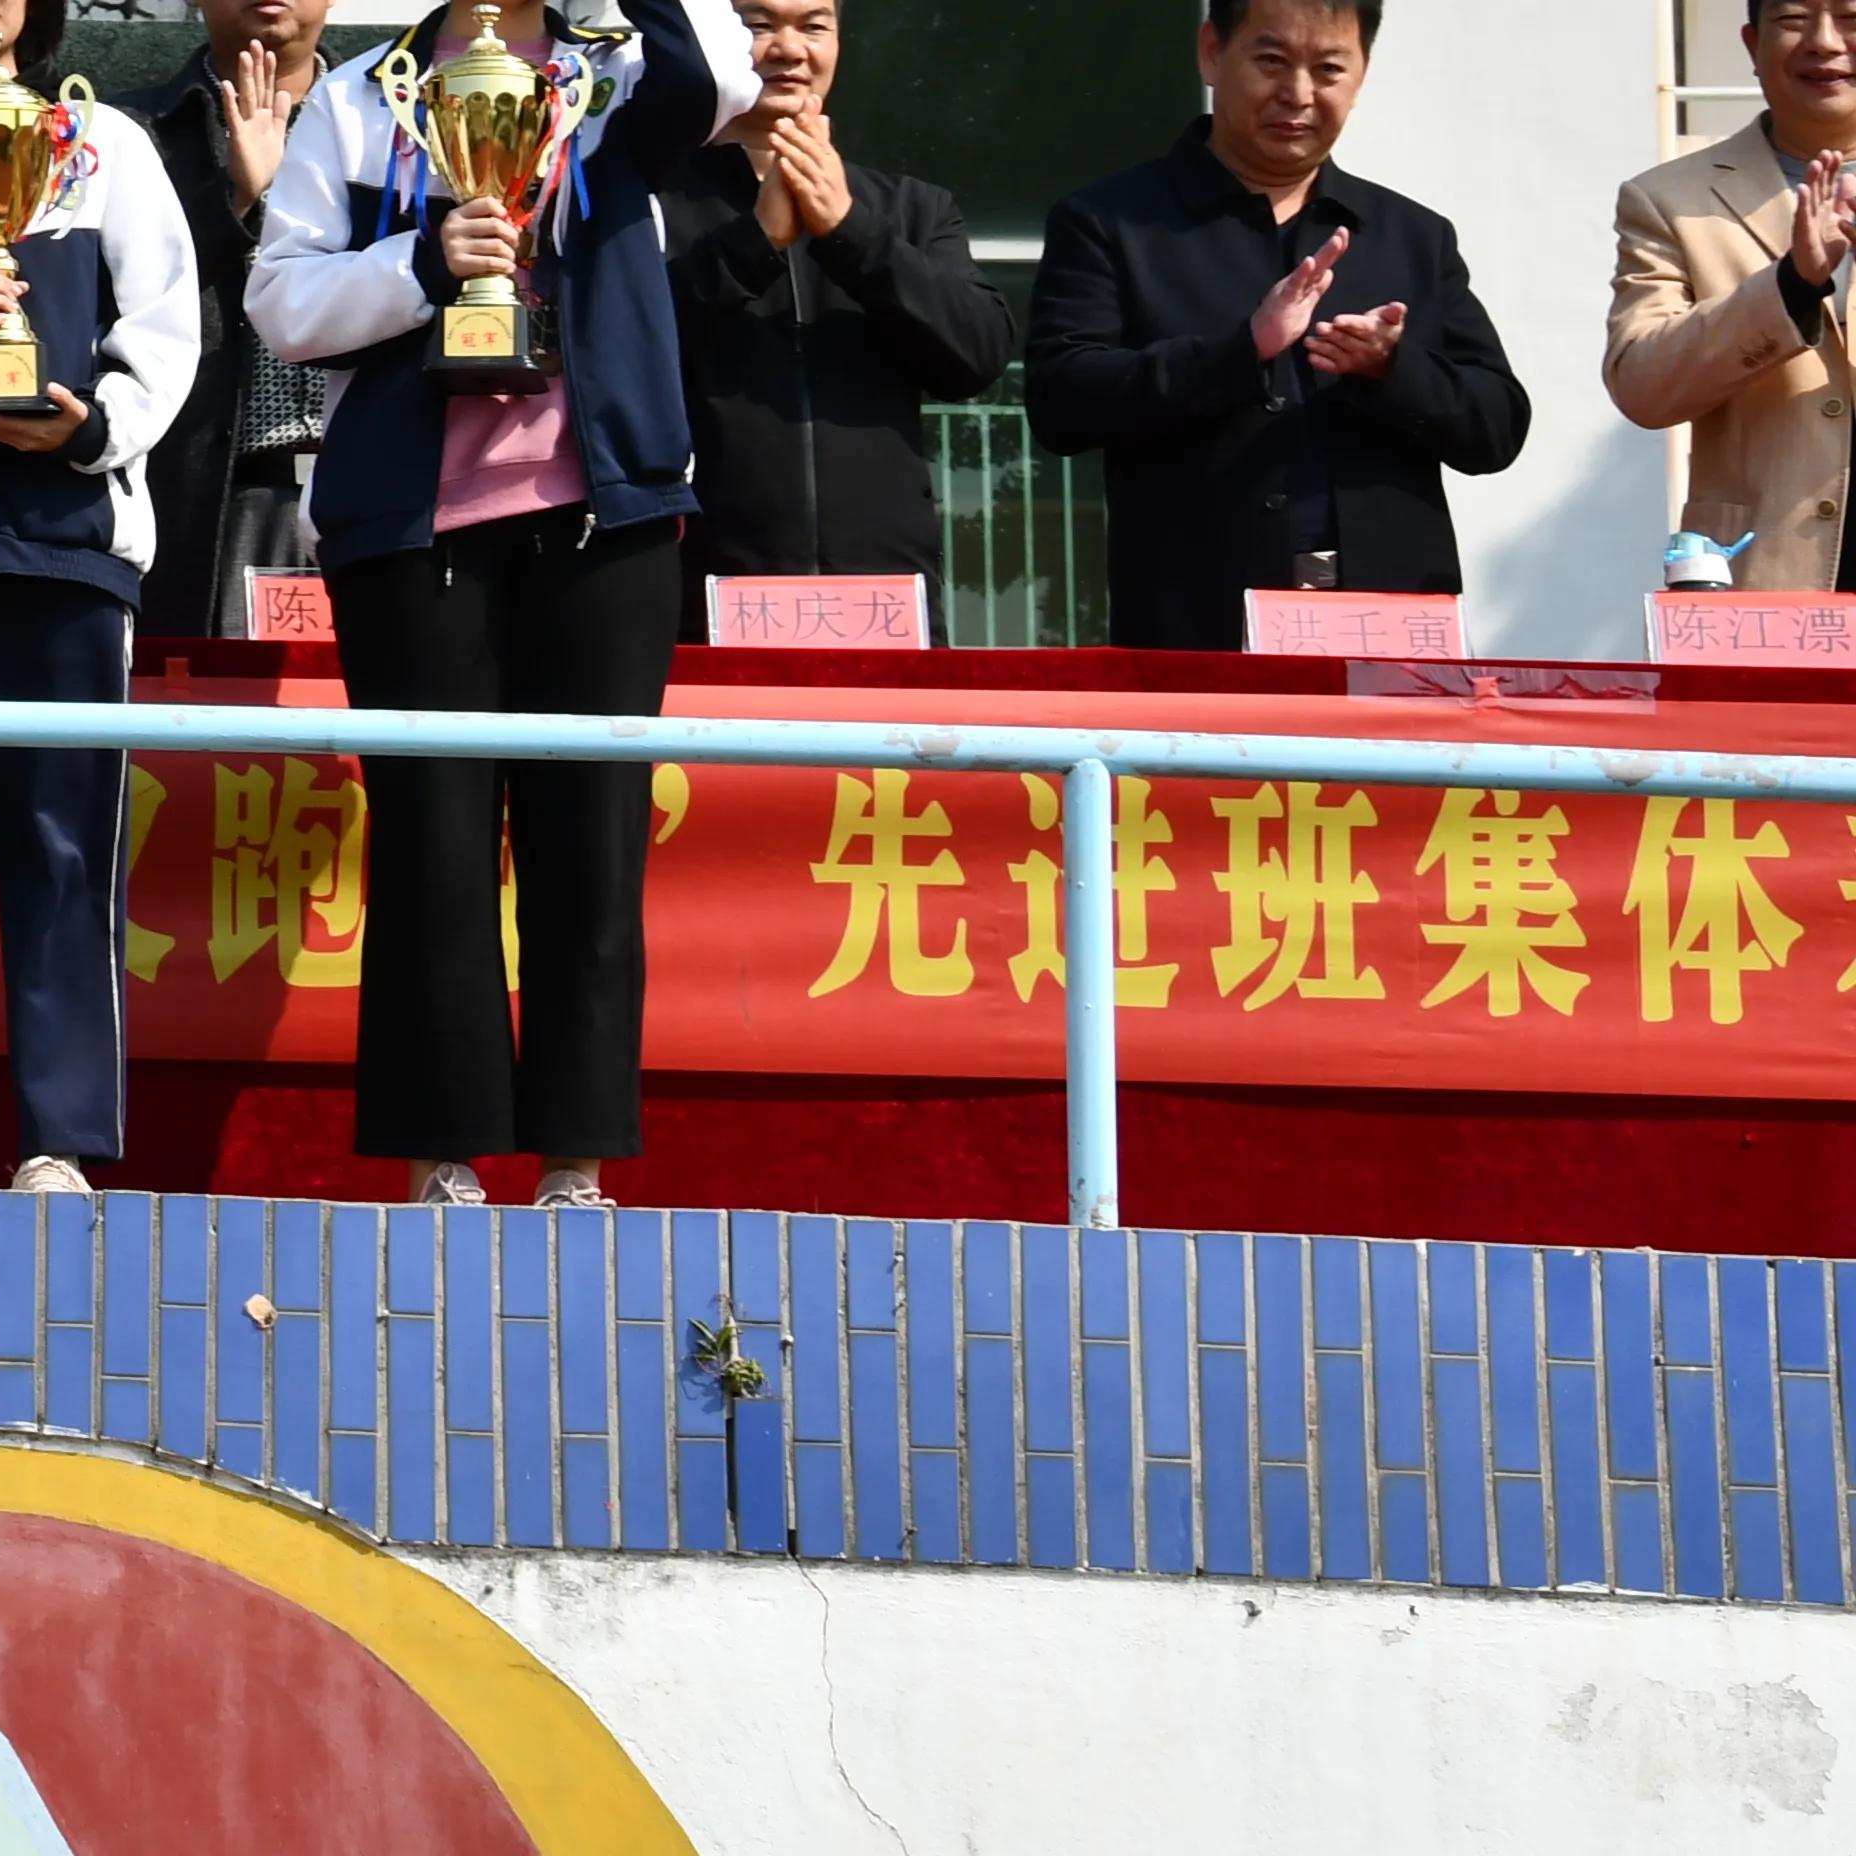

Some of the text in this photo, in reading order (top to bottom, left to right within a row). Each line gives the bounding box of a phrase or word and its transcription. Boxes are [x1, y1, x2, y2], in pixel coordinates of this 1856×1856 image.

[728, 590, 910, 640] 林庆龙
[1662, 603, 1852, 654] 陈江漂
